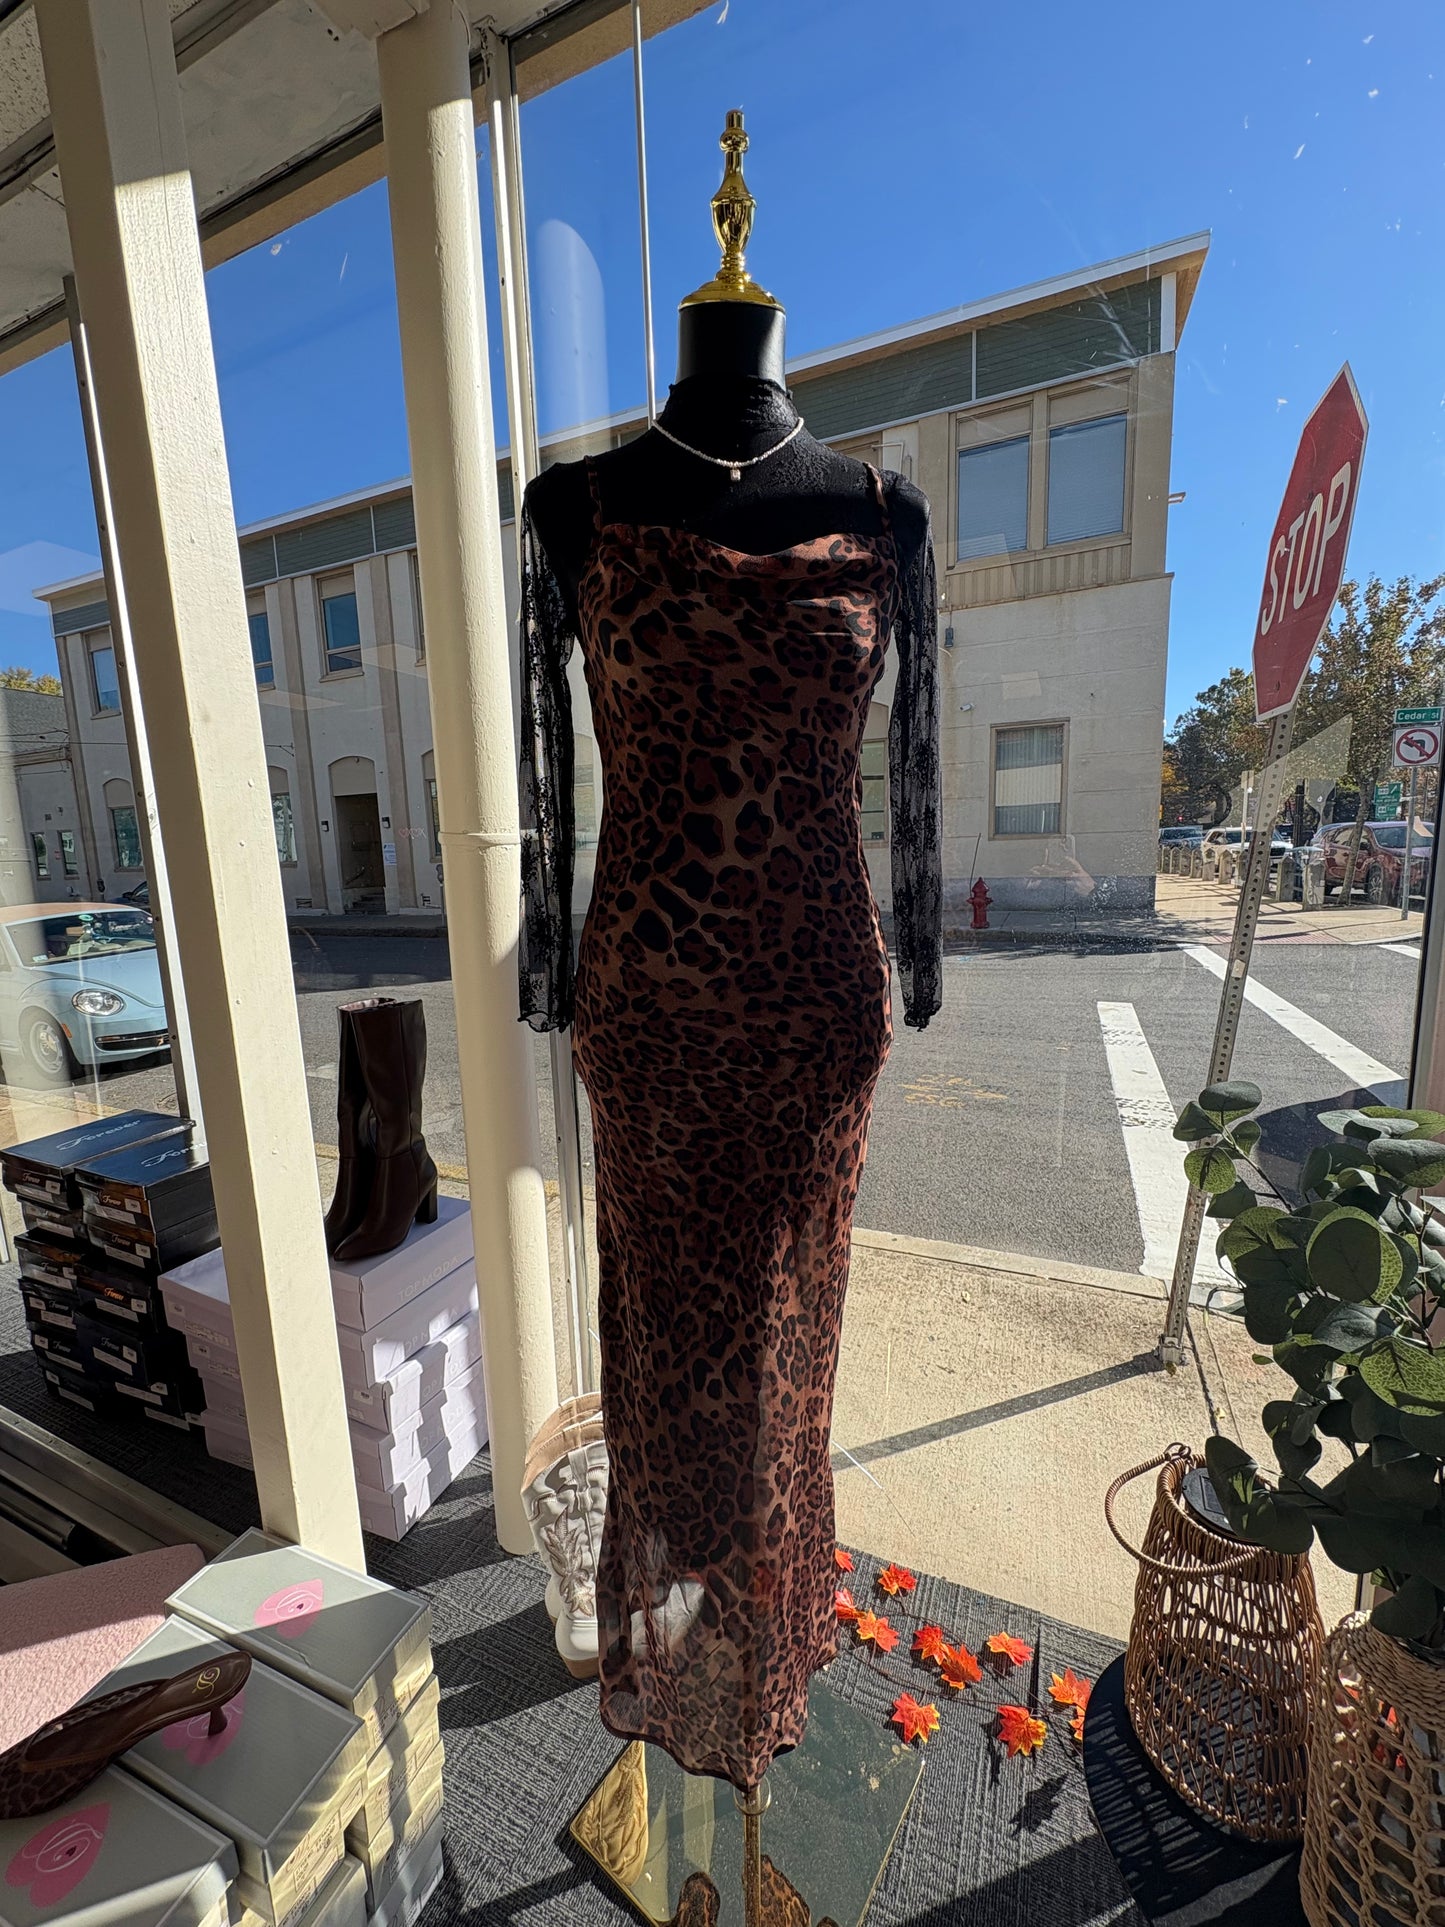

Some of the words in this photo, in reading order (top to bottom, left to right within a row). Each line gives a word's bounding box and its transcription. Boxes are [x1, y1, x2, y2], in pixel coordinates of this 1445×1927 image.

[1261, 461, 1351, 636] STOP
[1397, 712, 1427, 721] Cedar
[56, 1120, 141, 1151] Forever
